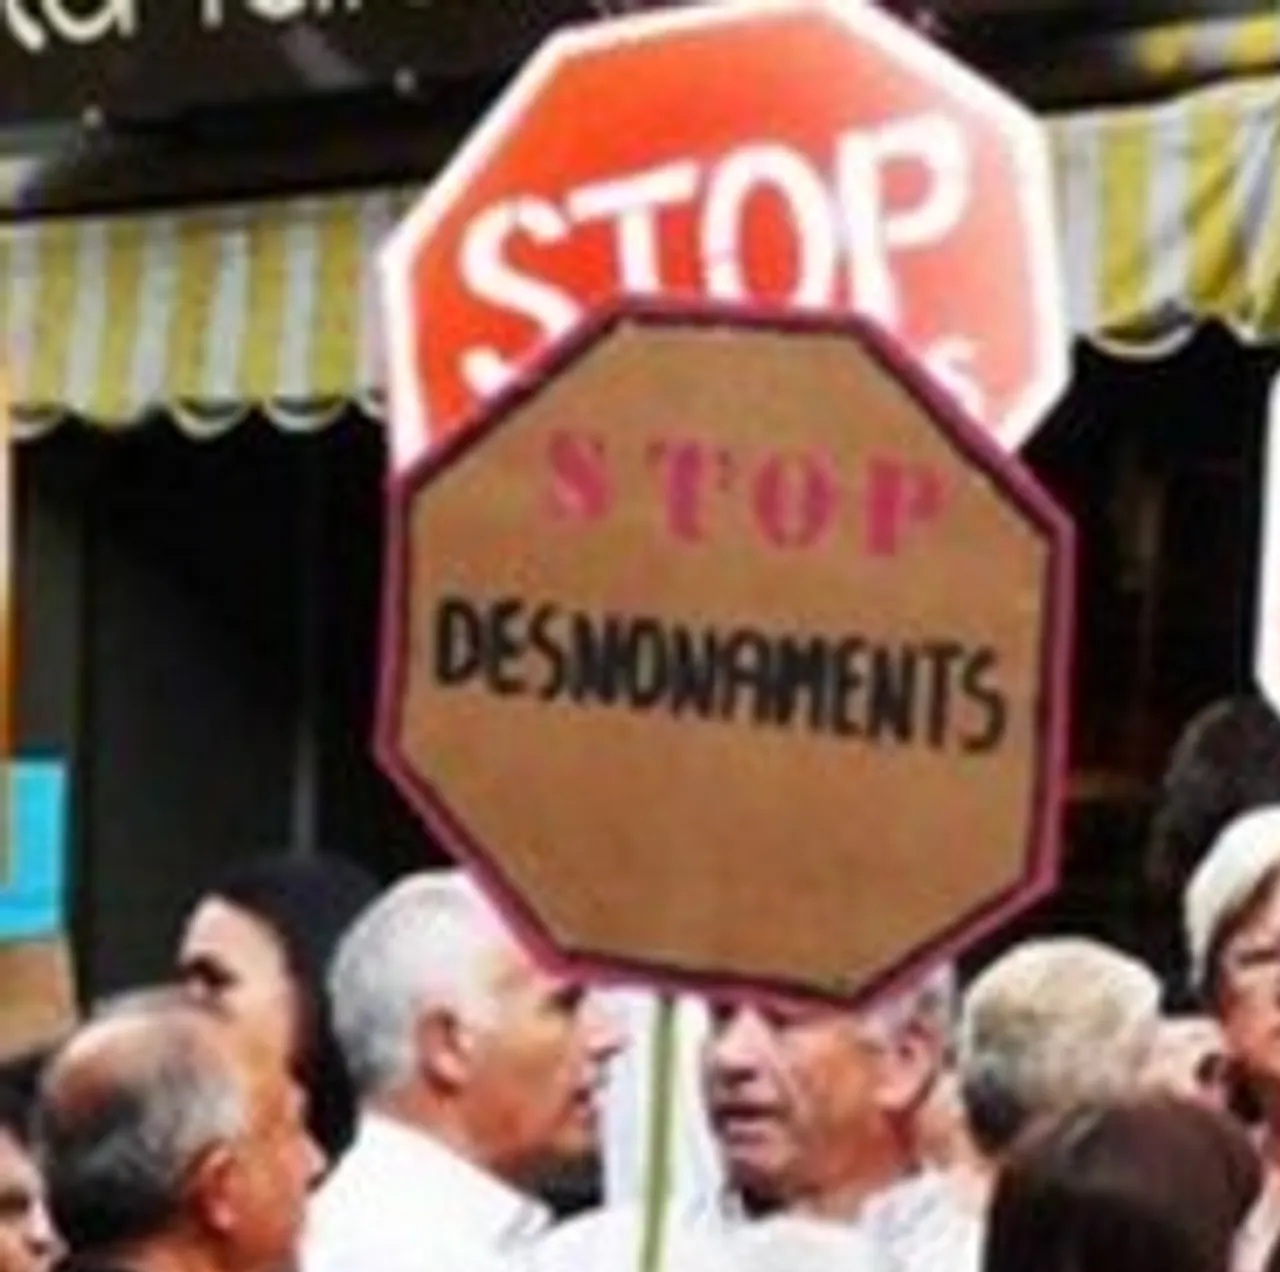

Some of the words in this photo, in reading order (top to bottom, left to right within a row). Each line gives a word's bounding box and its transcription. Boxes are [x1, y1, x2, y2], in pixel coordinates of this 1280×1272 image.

[458, 112, 966, 400] STOP
[544, 428, 945, 556] STOP
[434, 596, 1006, 754] DESNONAMENTS
